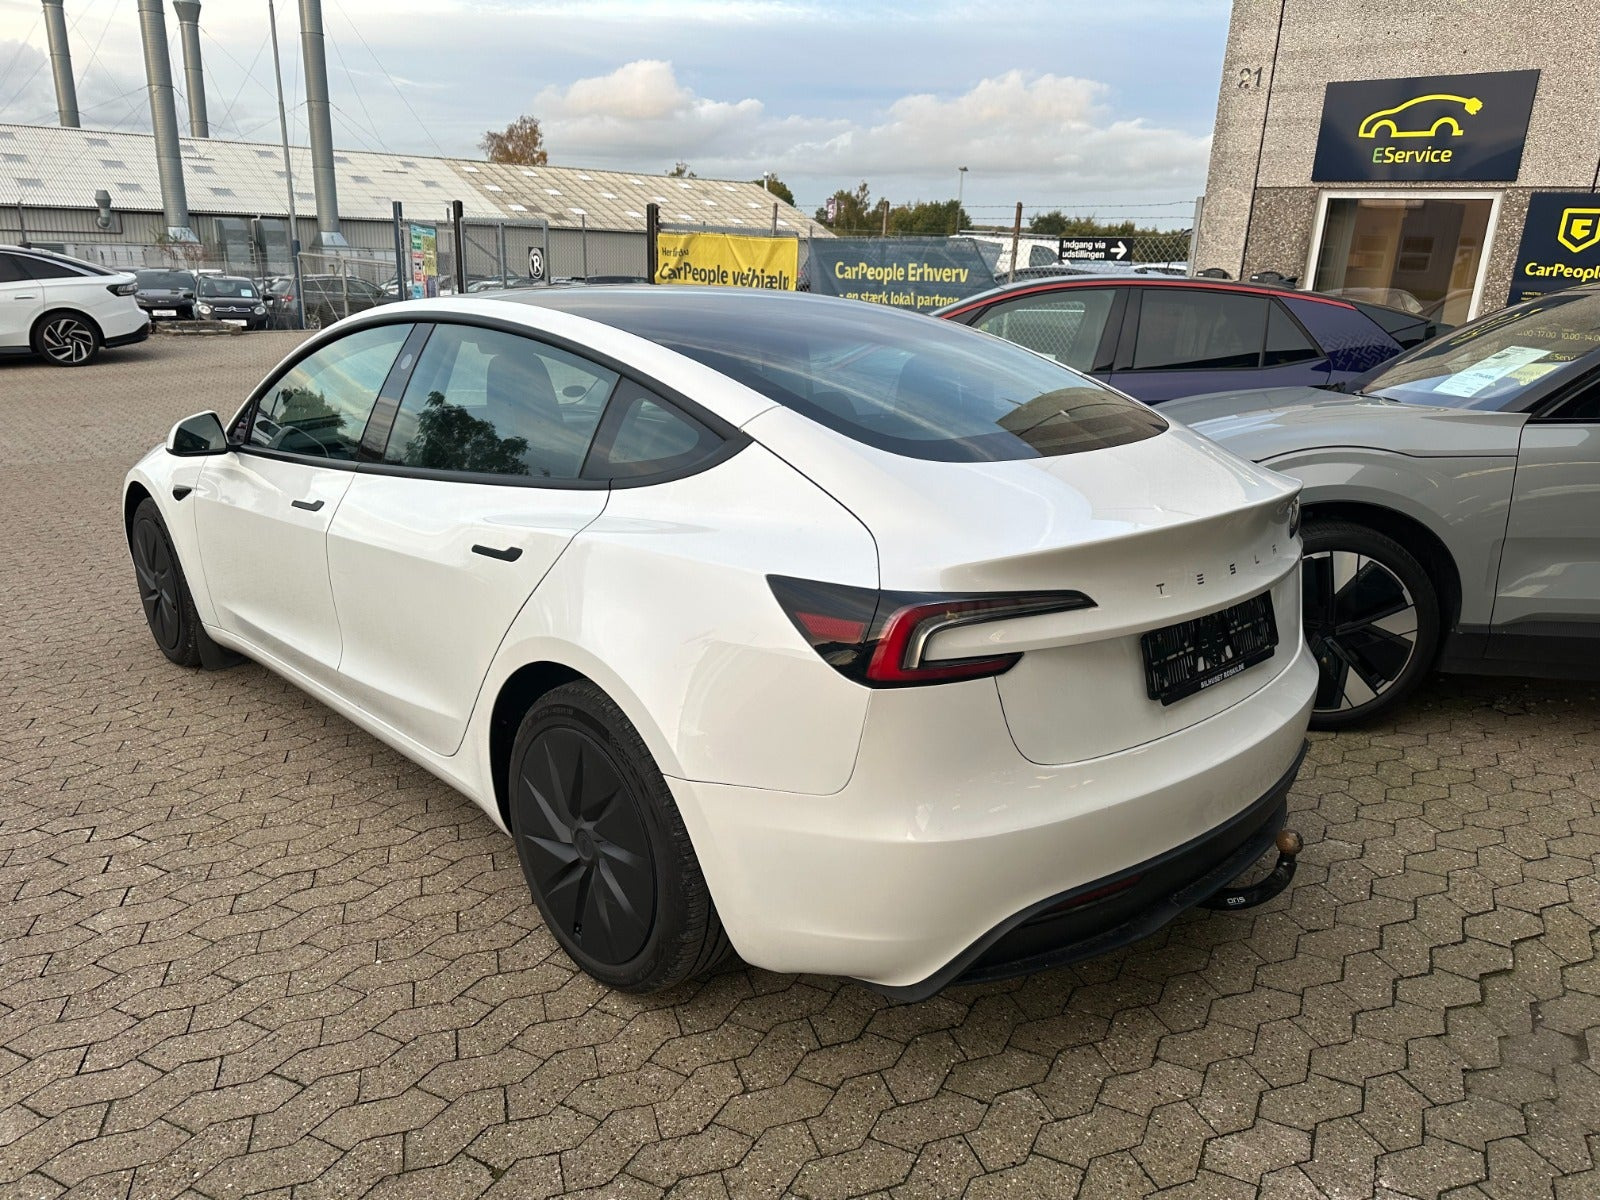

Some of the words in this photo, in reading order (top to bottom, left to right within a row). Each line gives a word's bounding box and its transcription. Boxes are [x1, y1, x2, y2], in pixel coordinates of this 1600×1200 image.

[1372, 145, 1453, 164] EService
[1062, 250, 1105, 260] udstillingen
[1063, 240, 1093, 250] Indgang
[1094, 240, 1106, 249] via
[660, 262, 728, 285] CarPeople
[834, 261, 904, 285] CarPeople
[907, 263, 969, 283] Erhverv
[1525, 262, 1600, 283] CarPeopl
[860, 291, 889, 304] stærk
[890, 291, 914, 306] lokal
[1156, 543, 1277, 595] TESLA
